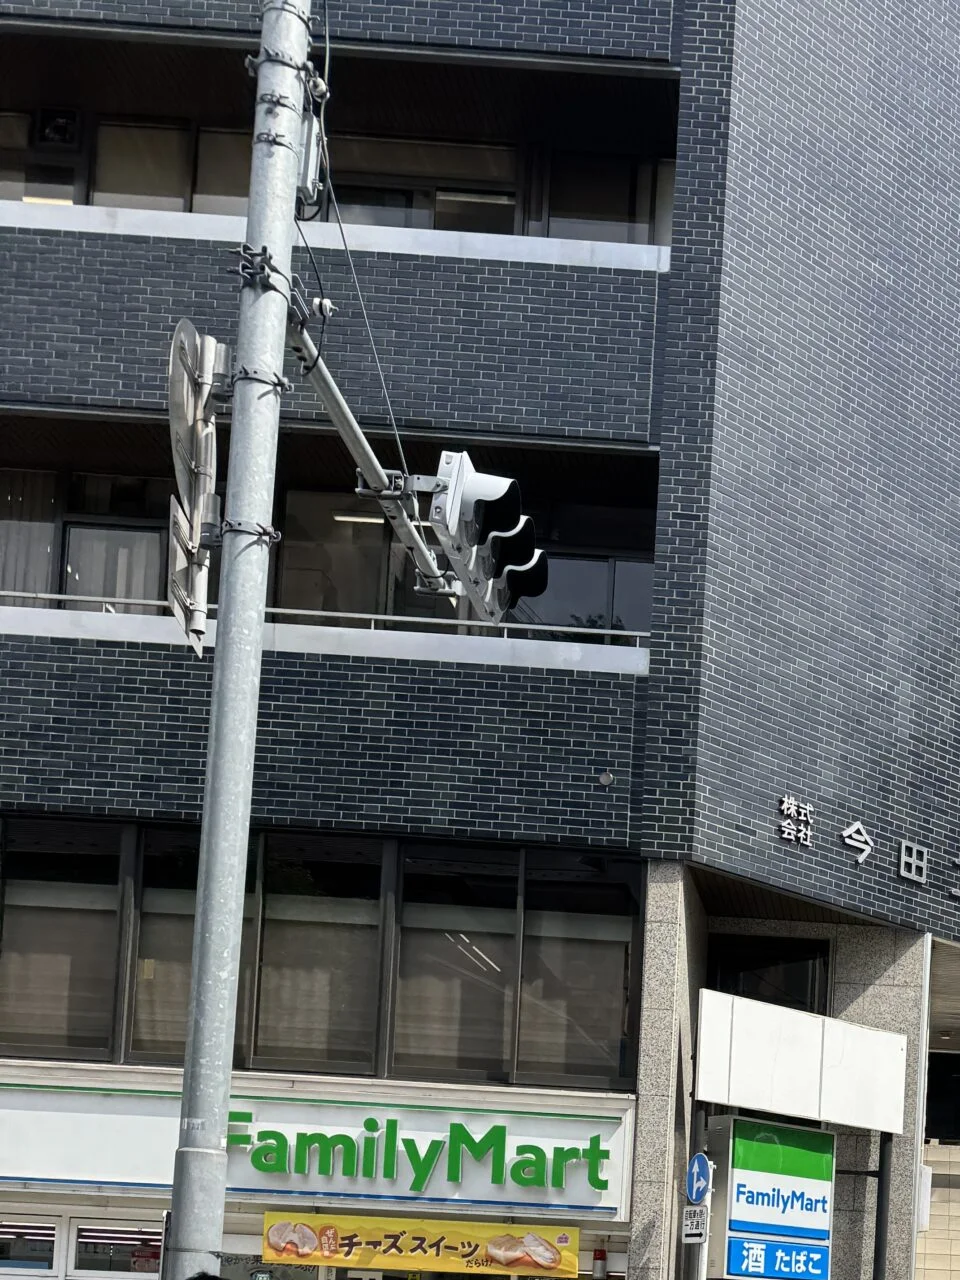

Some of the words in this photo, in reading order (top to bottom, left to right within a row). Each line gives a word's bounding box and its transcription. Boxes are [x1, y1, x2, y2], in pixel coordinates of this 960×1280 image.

[780, 794, 814, 824] 株式
[779, 819, 813, 847] 会社
[736, 1183, 828, 1214] FamilyMart
[684, 1221, 706, 1230] 一方通行
[339, 1230, 406, 1258] チーズ
[410, 1232, 480, 1259] スイーツ
[741, 1241, 766, 1274] 酒
[775, 1249, 822, 1274] たばこ
